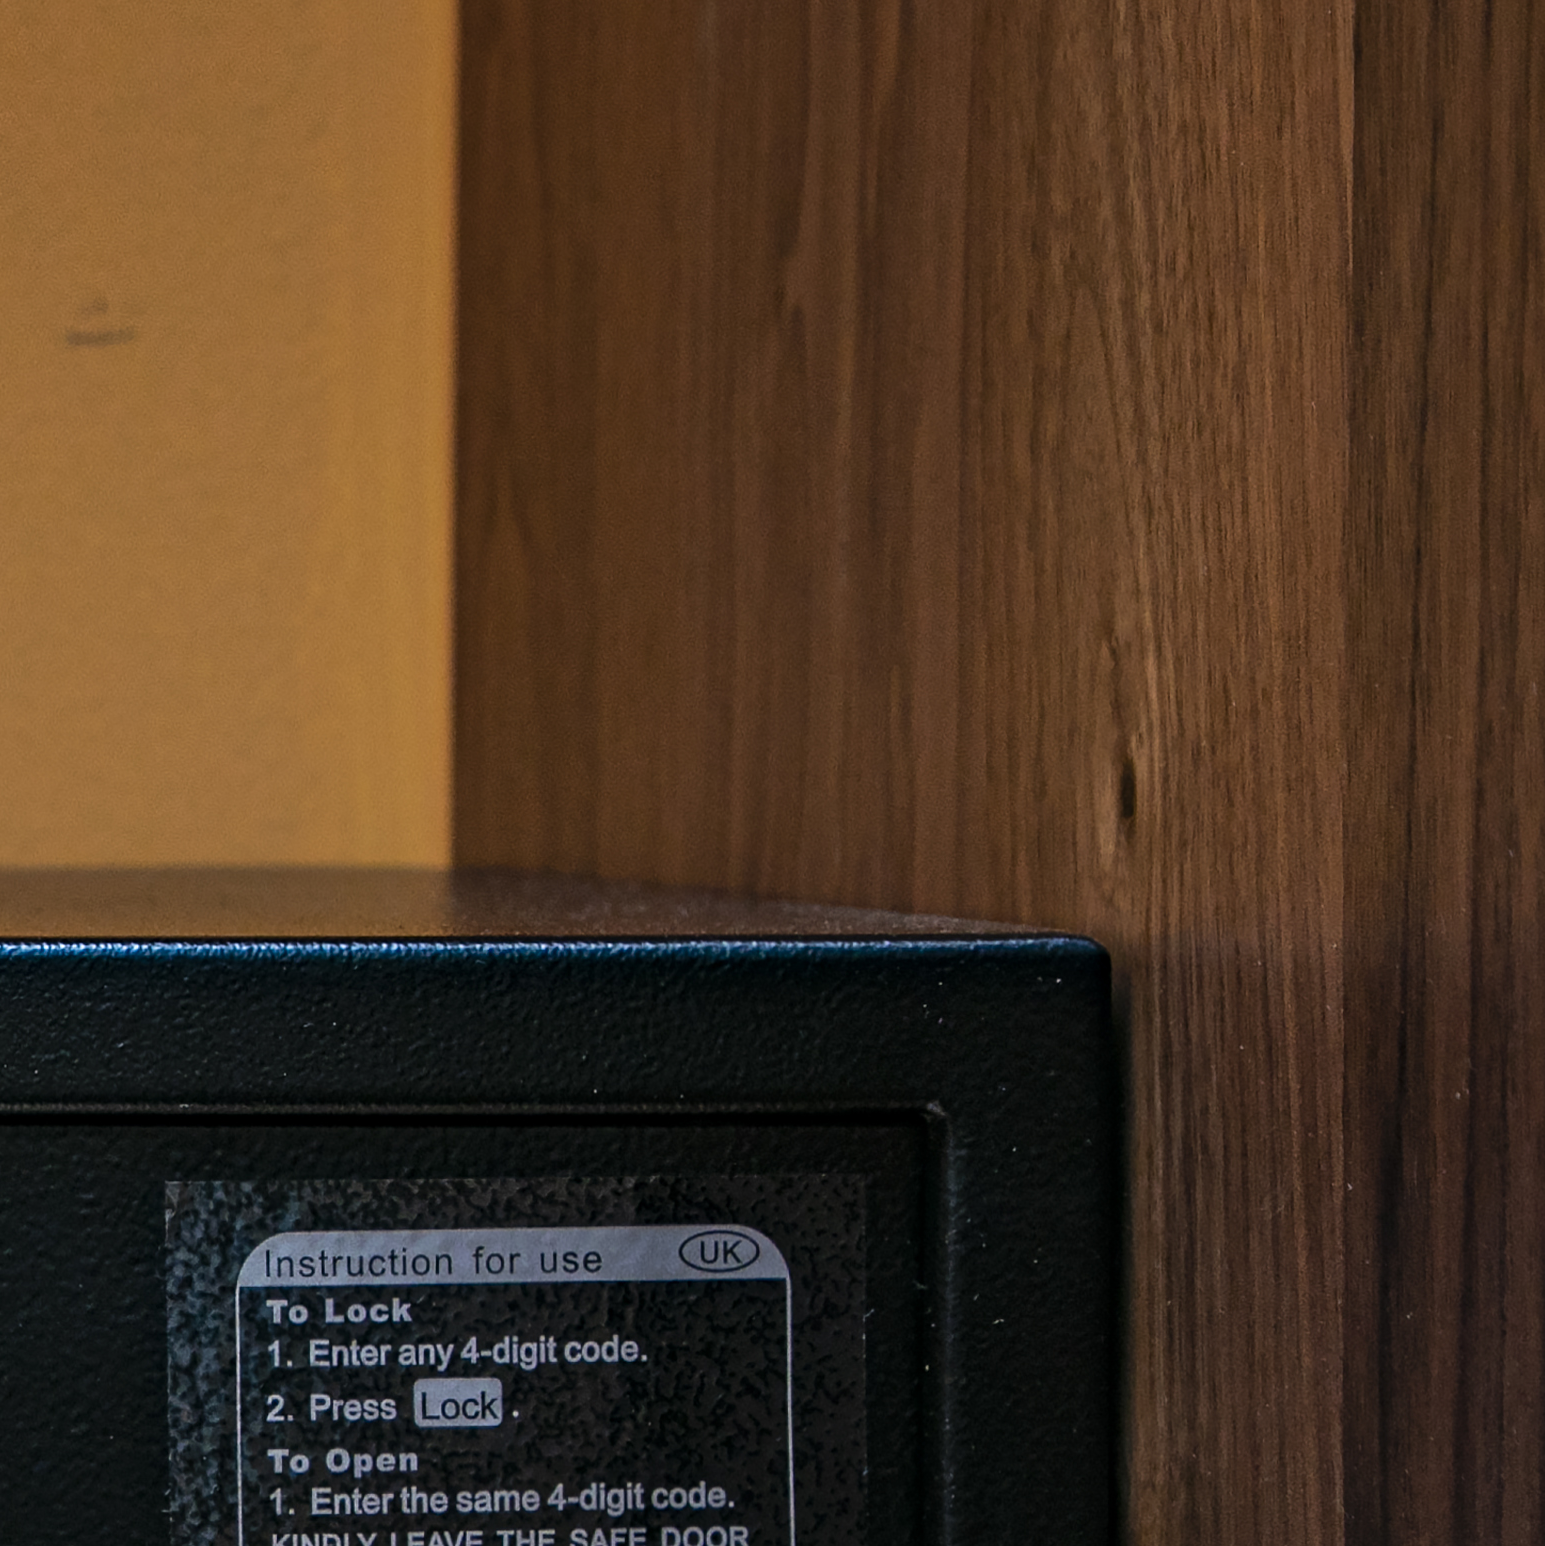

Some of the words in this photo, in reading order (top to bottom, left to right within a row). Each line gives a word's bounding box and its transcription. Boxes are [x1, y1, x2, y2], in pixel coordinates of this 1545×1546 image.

[265, 1249, 454, 1279] Instruction
[472, 1247, 520, 1275] for
[540, 1250, 602, 1274] use
[699, 1240, 743, 1265] UK
[266, 1301, 308, 1324] To
[325, 1298, 412, 1323] Lock
[268, 1342, 292, 1367] 1.
[309, 1339, 392, 1367] Enter
[399, 1343, 454, 1371] any
[461, 1337, 557, 1369] 4-digit
[564, 1336, 647, 1363] code.
[266, 1395, 293, 1421] 2.
[310, 1394, 397, 1420] Press
[420, 1392, 498, 1420] Lock
[268, 1450, 309, 1473] To
[326, 1449, 418, 1478] Open
[269, 1491, 295, 1516] 1.
[311, 1489, 394, 1516] Enter
[401, 1487, 448, 1514] the
[455, 1492, 540, 1513] same
[547, 1485, 644, 1517] 4-digit
[651, 1483, 735, 1510] code.
